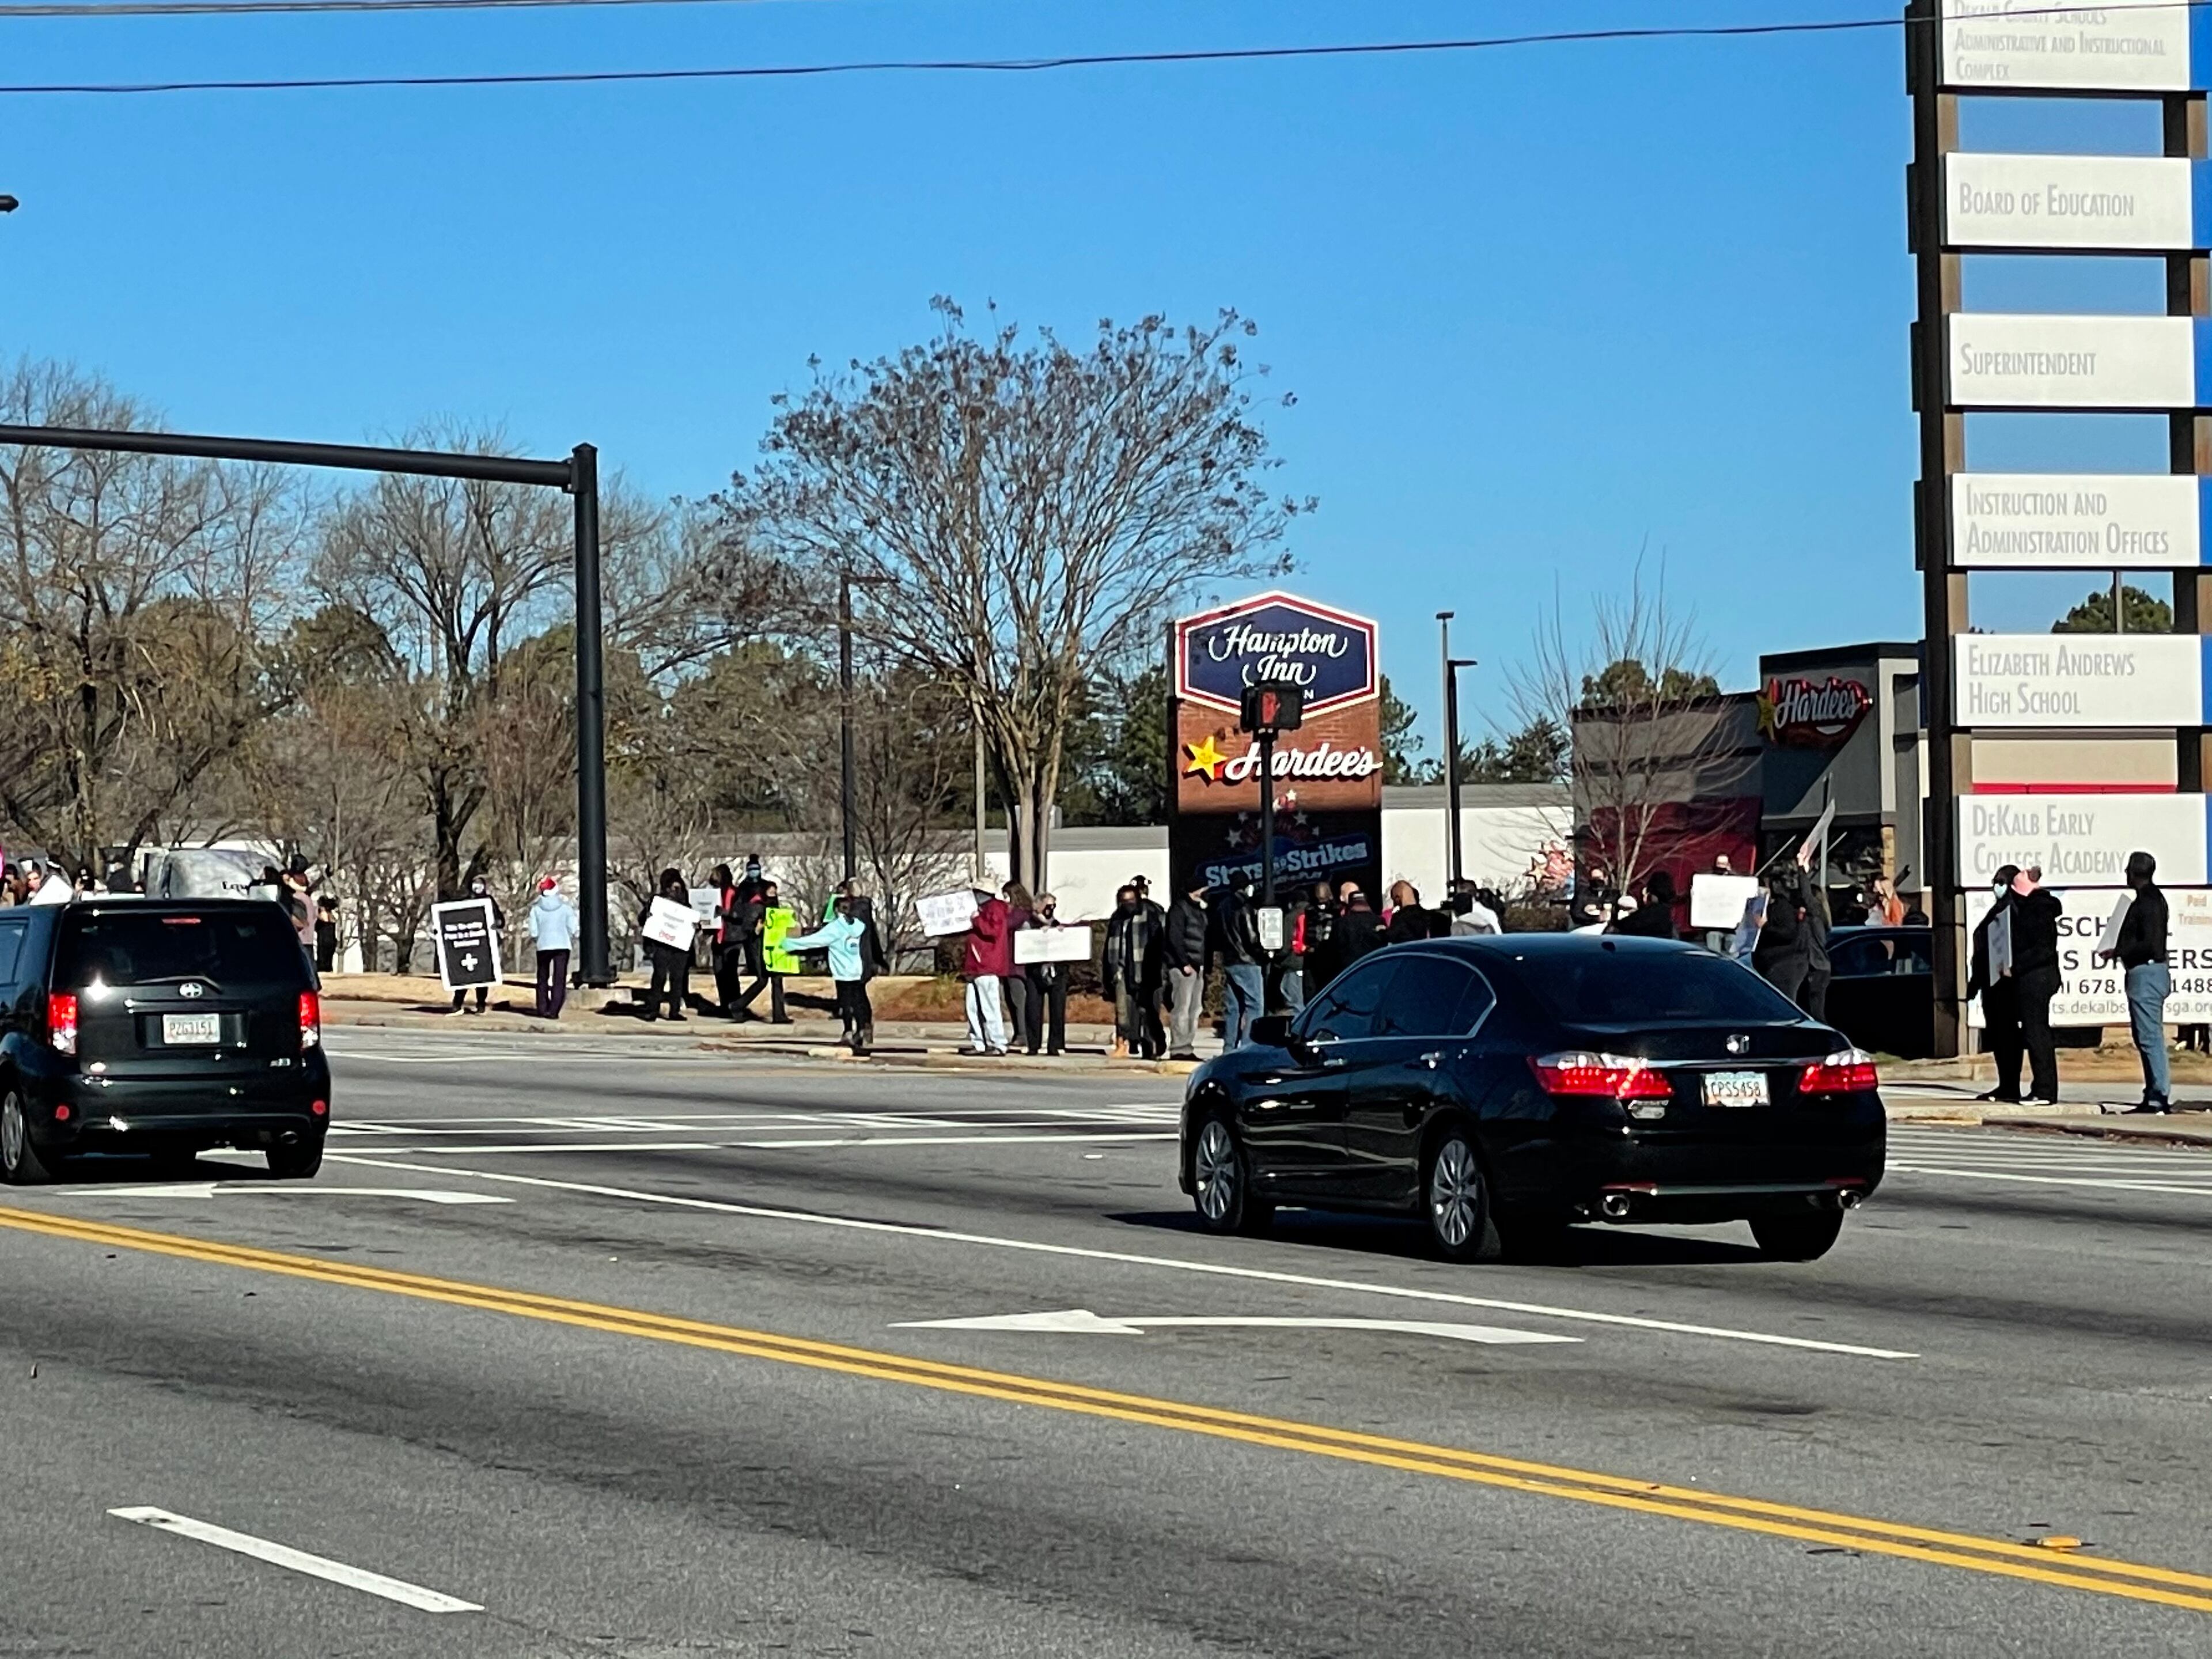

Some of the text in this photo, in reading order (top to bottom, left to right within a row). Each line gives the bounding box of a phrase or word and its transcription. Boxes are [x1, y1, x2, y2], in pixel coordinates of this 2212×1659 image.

[2051, 36, 2075, 53] AND
[1956, 56, 2010, 81] COMPLEX
[1959, 182, 2135, 217] BOARD OF EDUCATION
[1960, 343, 2097, 376] SUPERINTENDENT
[1966, 484, 2108, 516] INSTRUCTION AND
[1966, 521, 2169, 554] ADMINISTRATION OFFICES
[1209, 624, 1348, 662] Hampton
[1242, 654, 1317, 687] Inn
[1968, 644, 2135, 676] ELIZABETH ANDREWS
[1968, 683, 2081, 715] HIGH SCHOOL
[2047, 804, 2095, 836] EARLY
[1286, 842, 1368, 872] Strikes
[2048, 842, 2126, 874] ACADEMY
